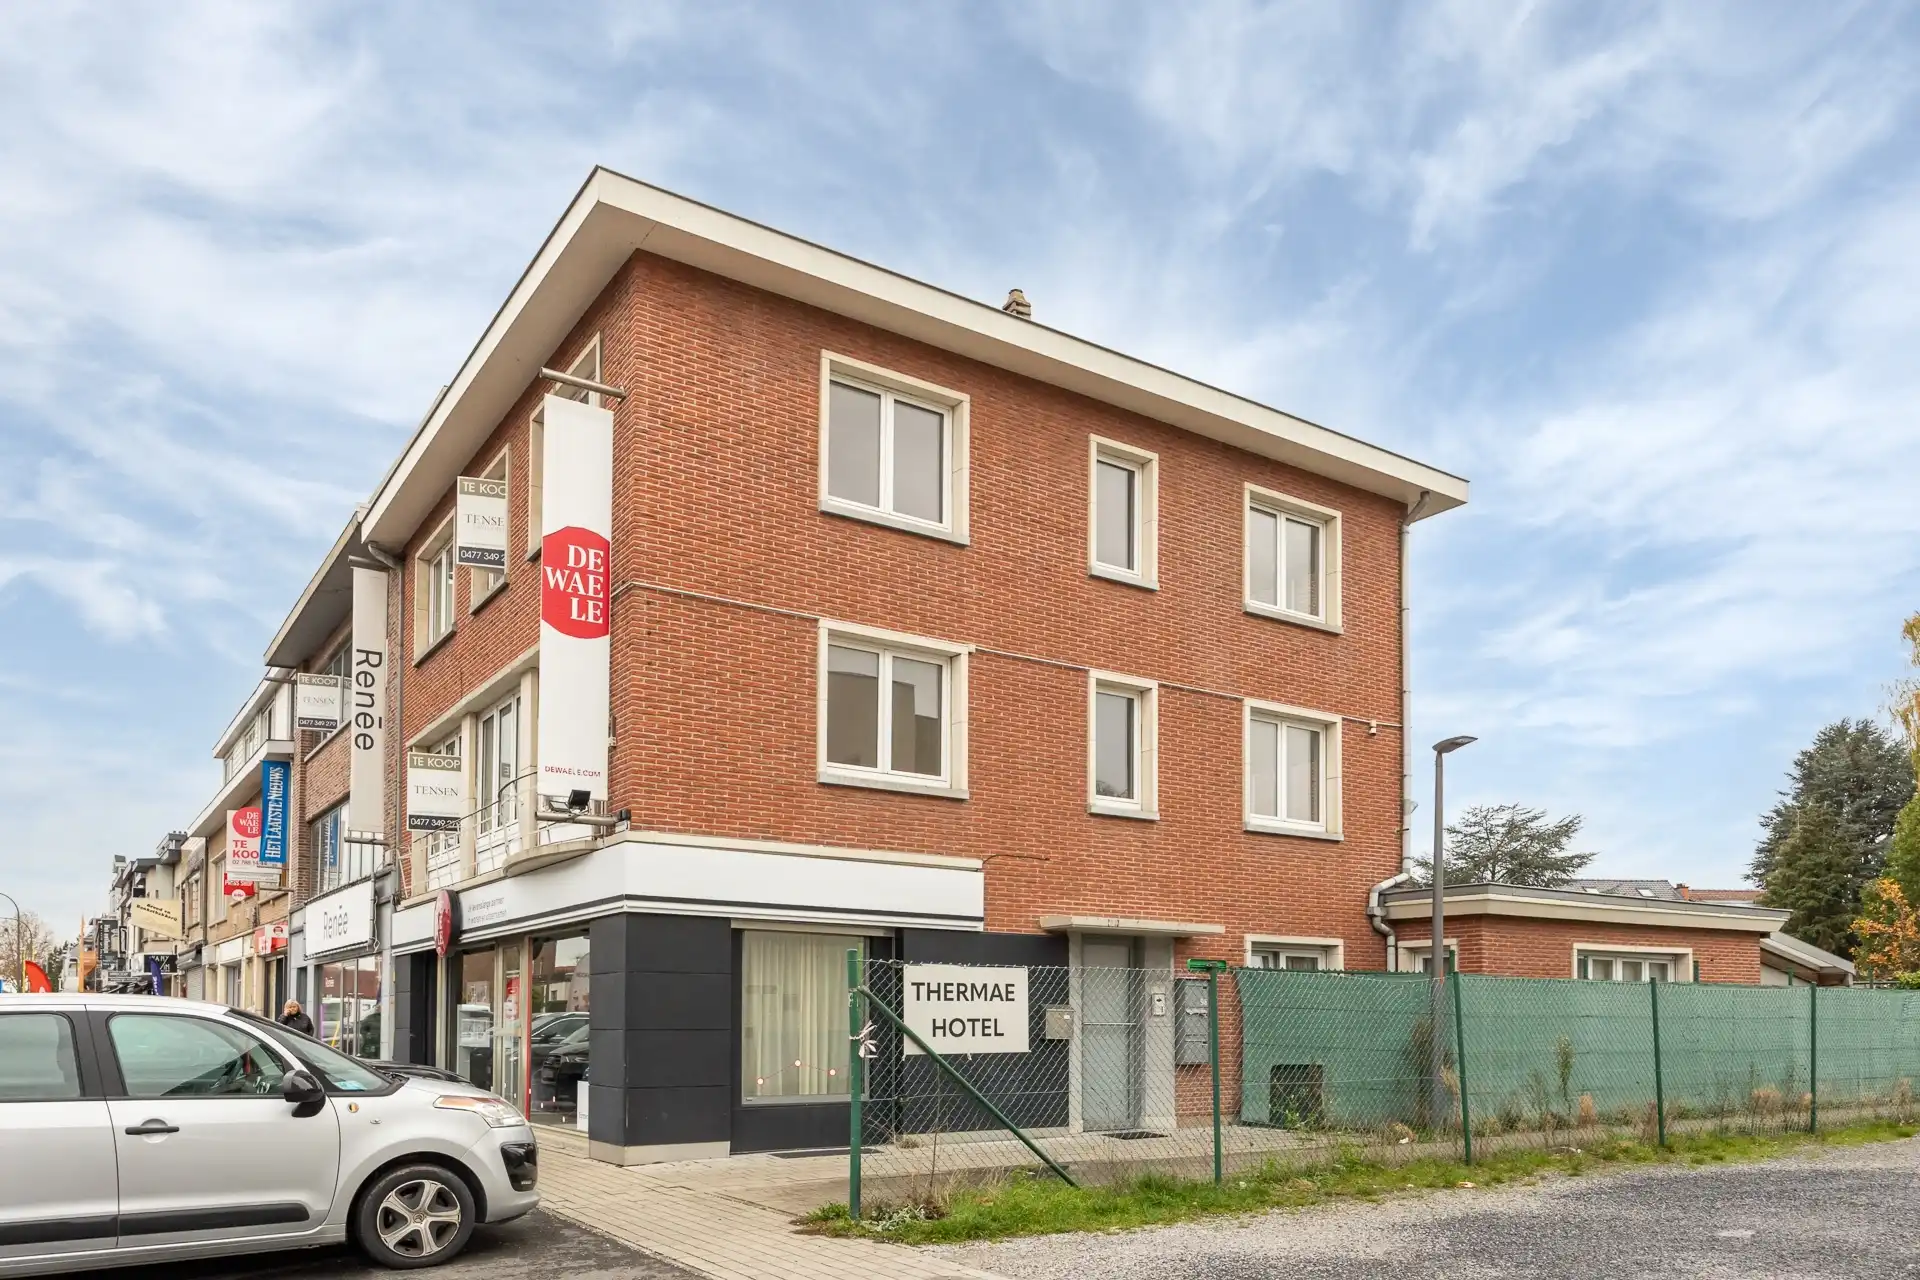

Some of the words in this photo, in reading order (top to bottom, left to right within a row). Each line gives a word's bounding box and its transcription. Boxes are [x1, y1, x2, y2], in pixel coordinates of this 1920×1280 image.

[463, 481, 475, 493] TE
[460, 549, 482, 560] 0477
[483, 552, 500, 561] 349
[567, 543, 604, 573] DE
[543, 565, 604, 599] WAE
[570, 596, 604, 624] LE
[301, 675, 310, 684] TE
[312, 677, 337, 686] KOOP
[412, 756, 424, 767] TE
[427, 757, 461, 769] KOOP
[544, 765, 601, 778] DEWAELE.COM
[413, 784, 459, 797] TENSEN
[246, 811, 259, 820] DE
[410, 817, 430, 826] 0477
[431, 818, 446, 827] 349
[239, 818, 259, 827] WAE
[247, 826, 259, 835] LE
[232, 839, 248, 849] TE
[264, 840, 282, 859] HET
[911, 981, 1016, 1002] THERMAE
[932, 1017, 1005, 1038] HOTEL
